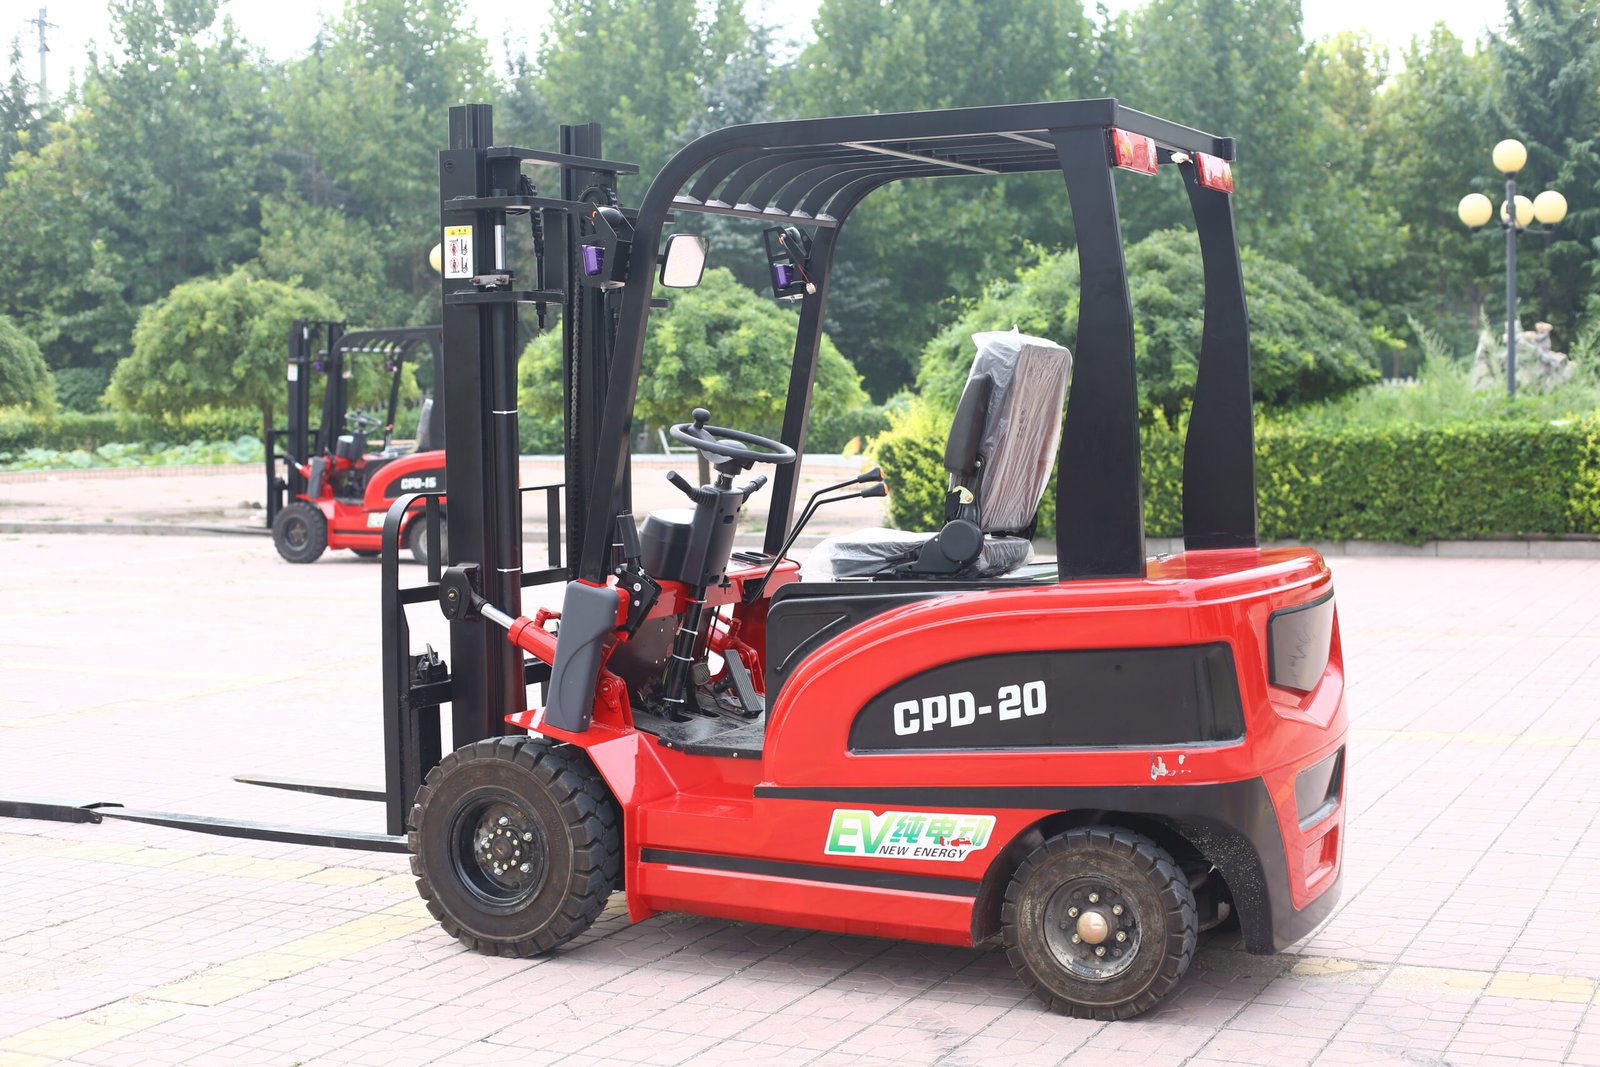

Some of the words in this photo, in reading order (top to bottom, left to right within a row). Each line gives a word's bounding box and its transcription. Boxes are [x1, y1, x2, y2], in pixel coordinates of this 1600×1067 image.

[894, 680, 1047, 736] CPD-20
[828, 811, 897, 854] EV
[889, 814, 992, 847] 纯电动
[879, 845, 910, 856] NEW
[913, 847, 967, 859] ENERGY
